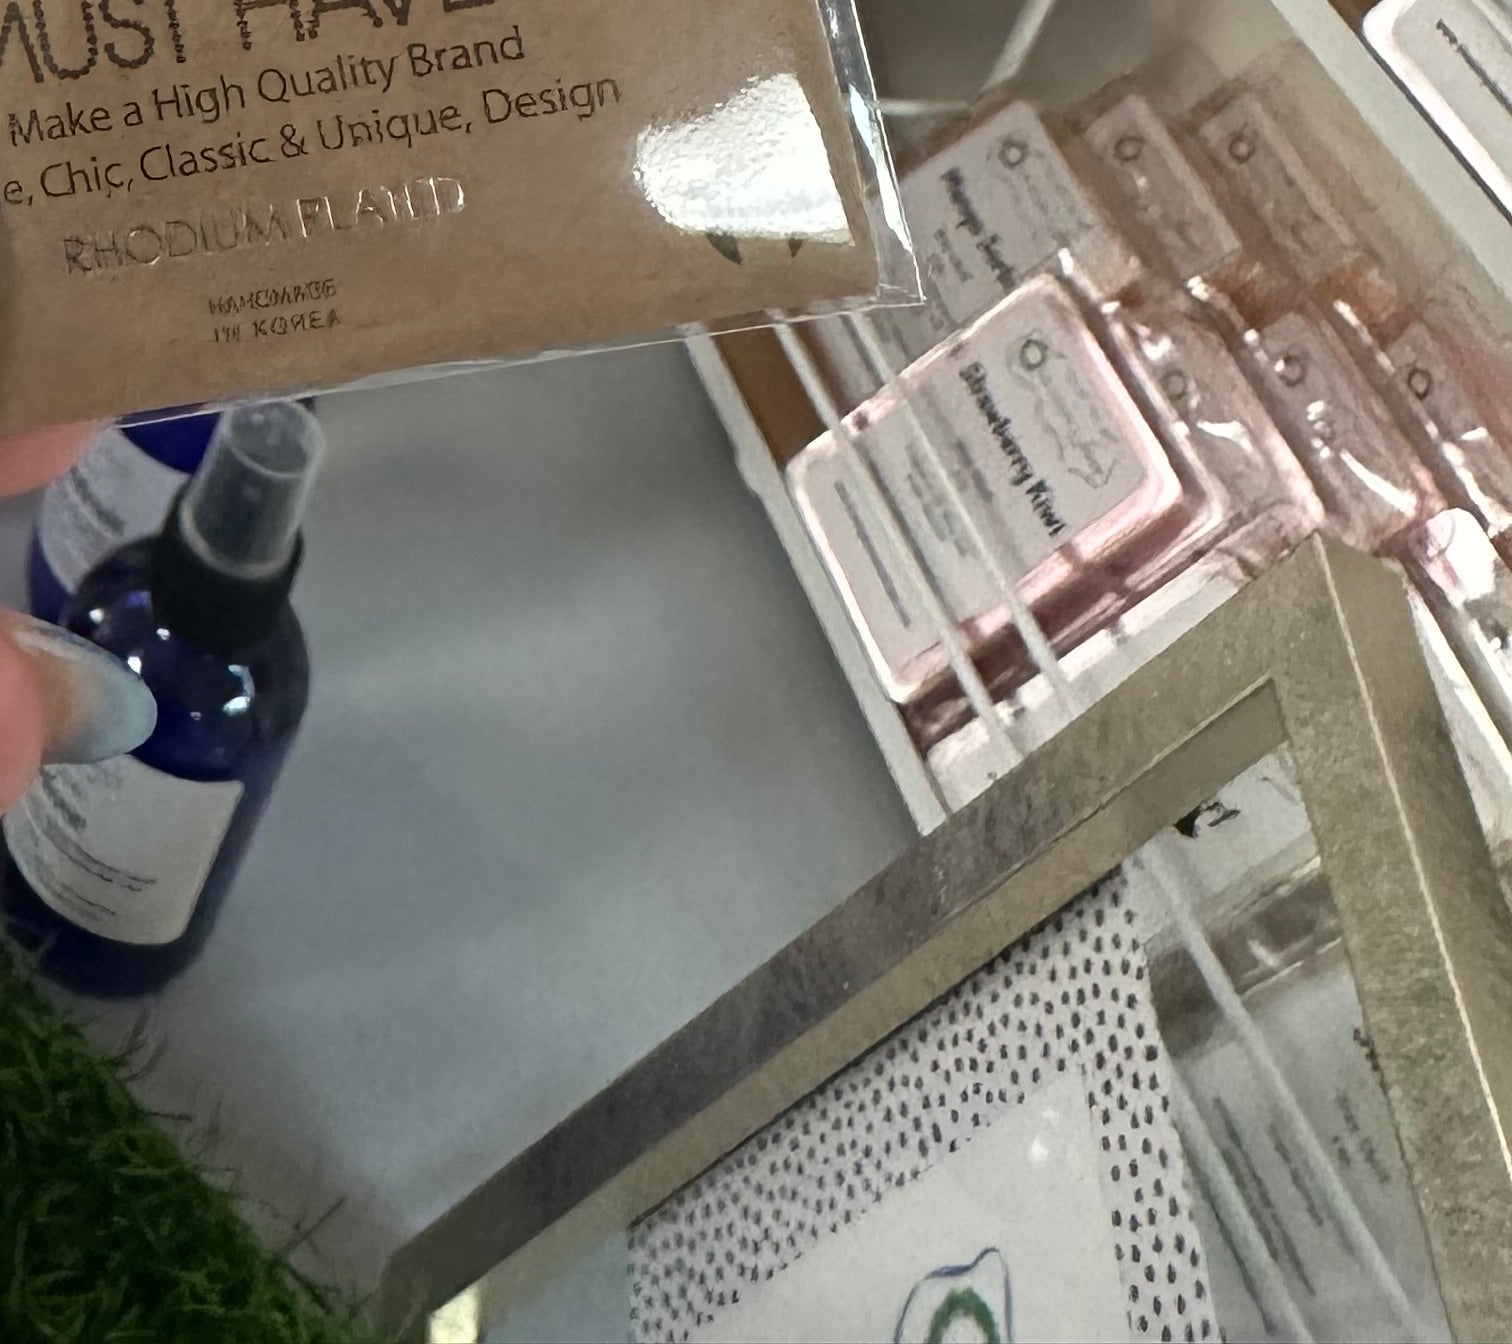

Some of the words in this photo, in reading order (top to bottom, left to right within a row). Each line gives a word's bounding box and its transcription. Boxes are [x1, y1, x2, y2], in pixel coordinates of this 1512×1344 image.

[8, 101, 113, 148] Make
[123, 101, 144, 127] a
[151, 74, 246, 125] High
[256, 53, 402, 104] Quality
[406, 24, 526, 78] Brand
[40, 156, 134, 199] Chic,
[139, 131, 279, 181] Classic
[279, 123, 309, 159] &
[316, 104, 472, 150] Unique,
[481, 77, 623, 125] Design
[62, 202, 288, 276] RHODIUM
[252, 307, 344, 339] KOREA
